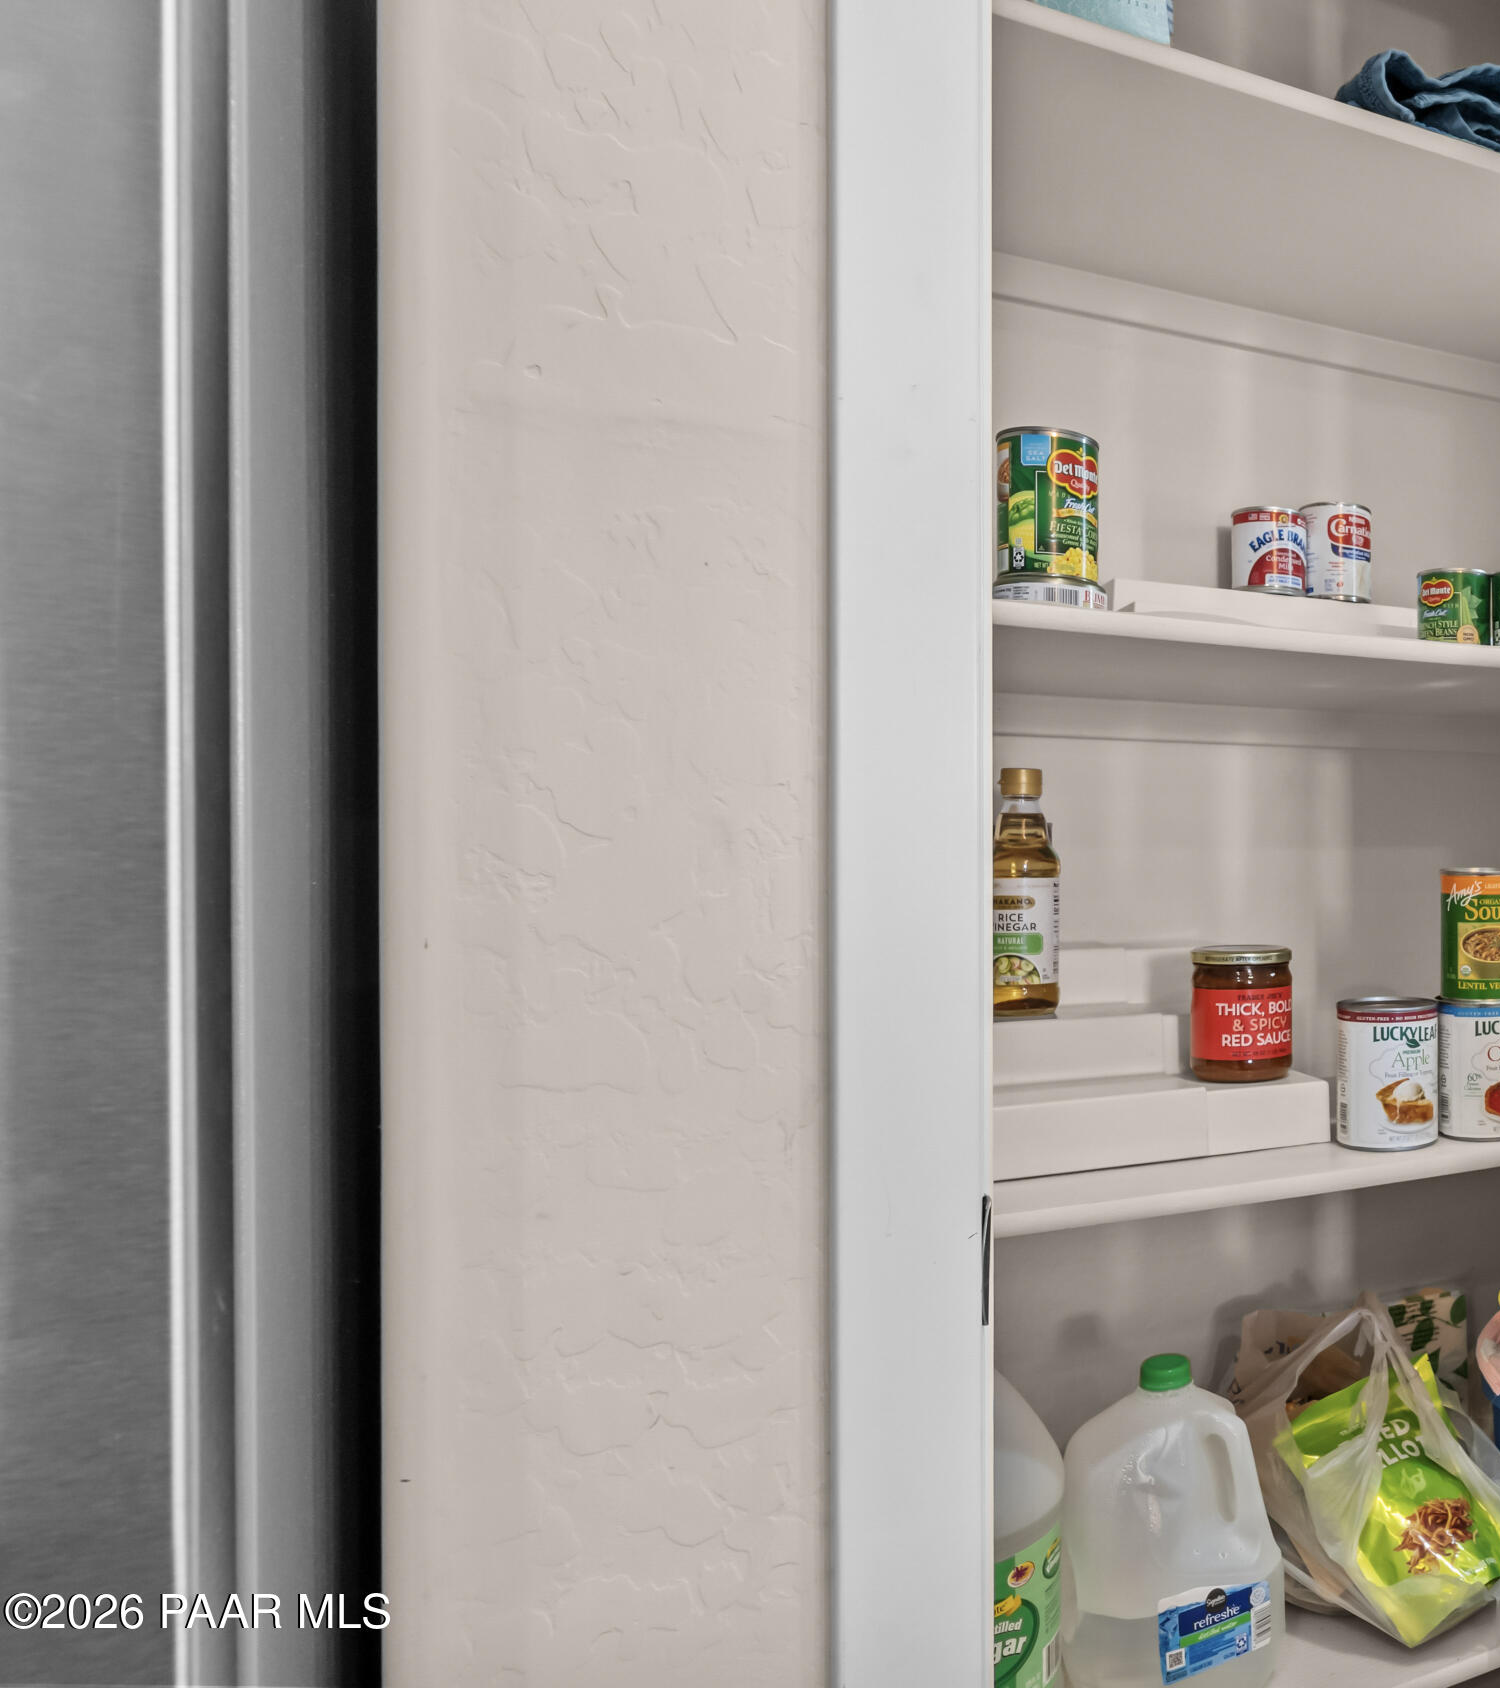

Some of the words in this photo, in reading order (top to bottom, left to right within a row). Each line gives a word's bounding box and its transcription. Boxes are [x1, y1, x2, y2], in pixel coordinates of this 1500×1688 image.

[1054, 461, 1073, 476] Del
[1446, 880, 1483, 911] Amy's
[998, 913, 1024, 922] RICE
[994, 922, 1037, 932] INEGAR
[1215, 1002, 1265, 1017] THICK,
[1232, 1019, 1244, 1032] &
[1250, 1015, 1287, 1031] SPICY
[1221, 1034, 1253, 1047] RED
[1256, 1029, 1291, 1047] SAUCE
[1392, 1048, 1430, 1071] Apple
